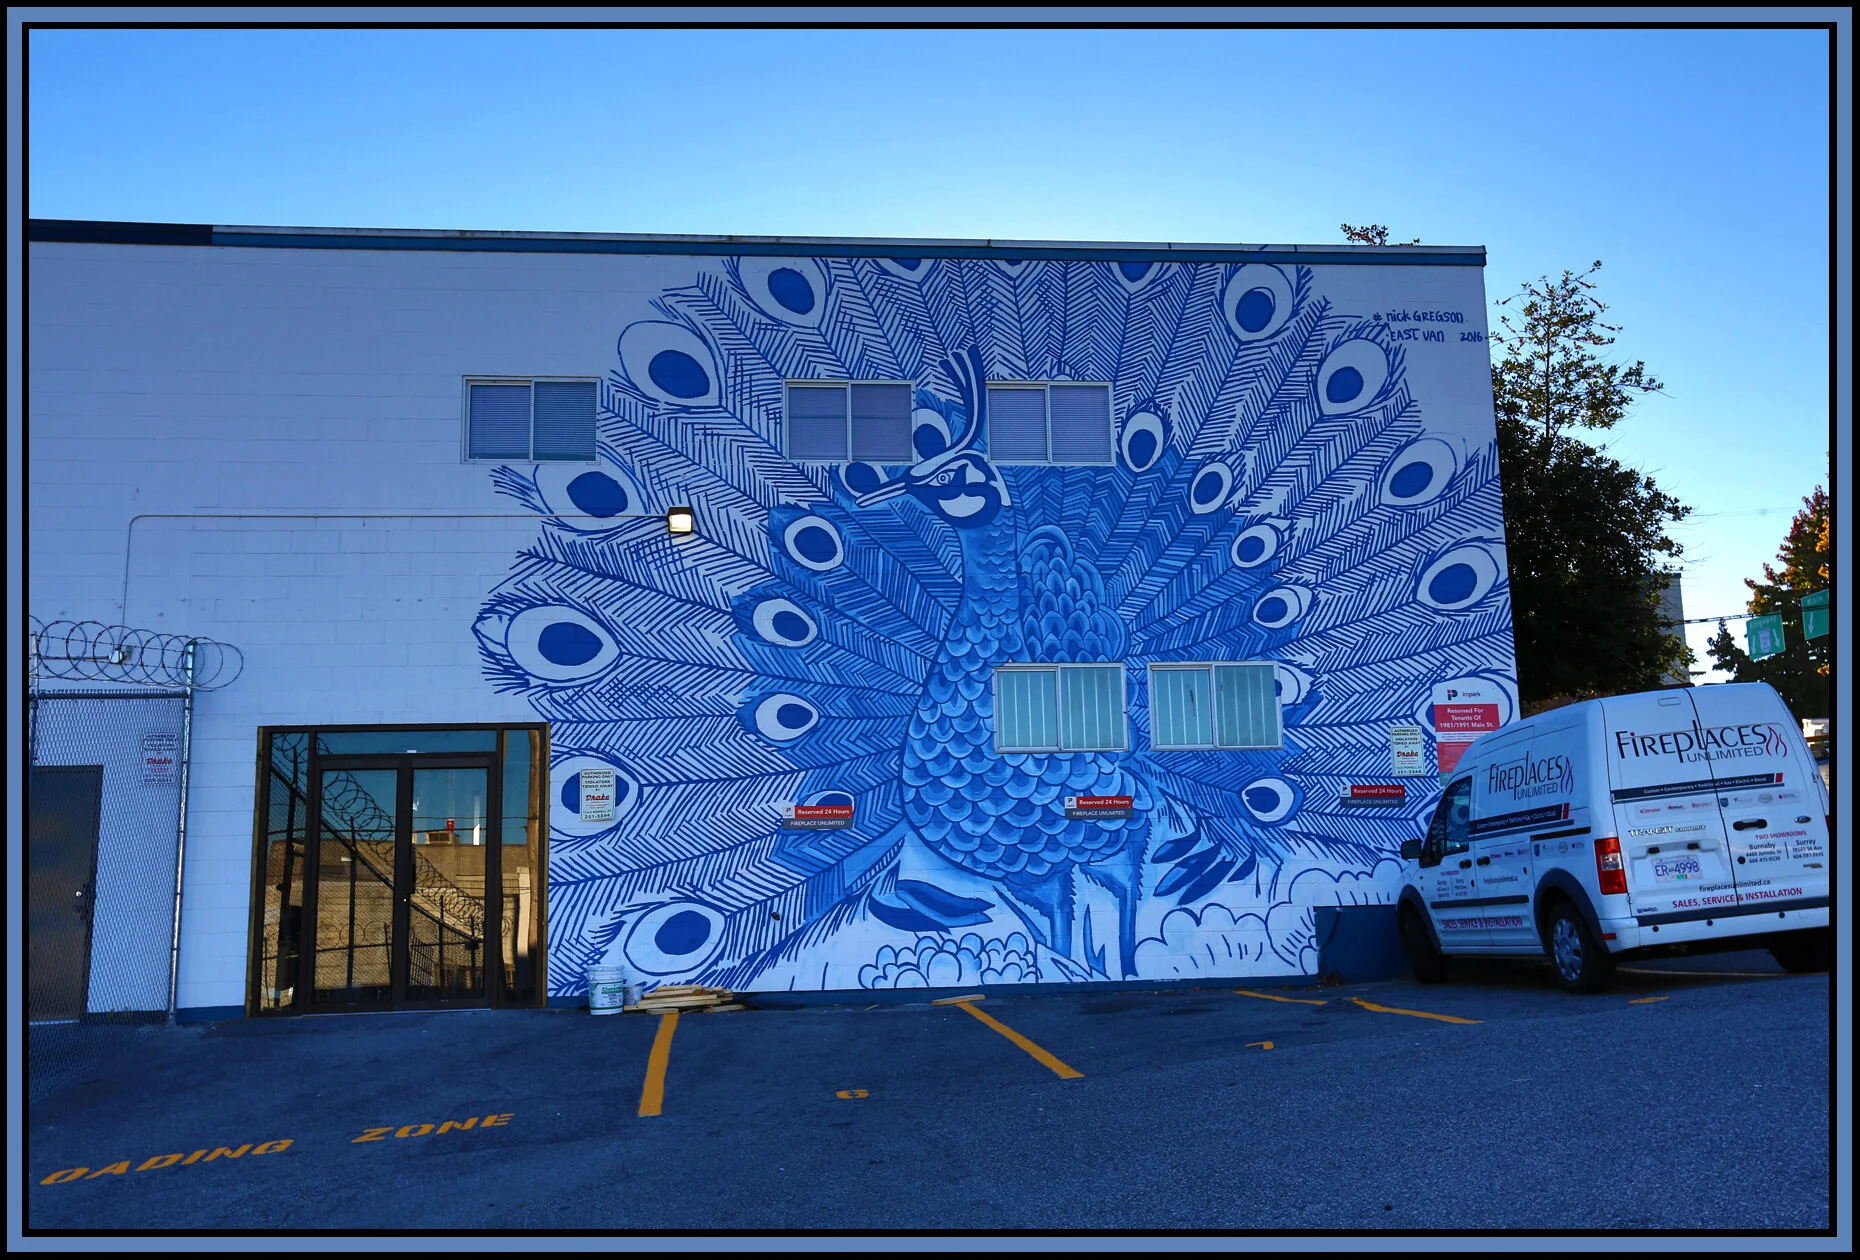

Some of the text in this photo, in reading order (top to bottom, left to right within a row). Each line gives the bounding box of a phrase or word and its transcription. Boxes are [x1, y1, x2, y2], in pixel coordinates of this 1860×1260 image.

[1386, 309, 1411, 322] nick
[1390, 328, 1420, 341] EAST
[1460, 331, 1483, 342] 2016
[1396, 750, 1419, 758] Drake
[1687, 746, 1763, 763] UNLIMITED
[1517, 782, 1558, 799] UNLIMITED
[1628, 825, 1673, 837] TRANSIT
[1770, 830, 1807, 839] SHOWROOMS
[1749, 842, 1776, 850] Burnaby
[1674, 861, 1700, 874] 4998
[1699, 879, 1771, 892] fireplacesunlimited.ca
[1672, 899, 1701, 908] SALES,
[1702, 895, 1734, 905] SERVICE
[1745, 887, 1803, 900] INSTALLATION
[1459, 917, 1478, 929] SERVICE
[1485, 915, 1523, 927] INSTALLATION
[351, 1113, 514, 1144] ZONE
